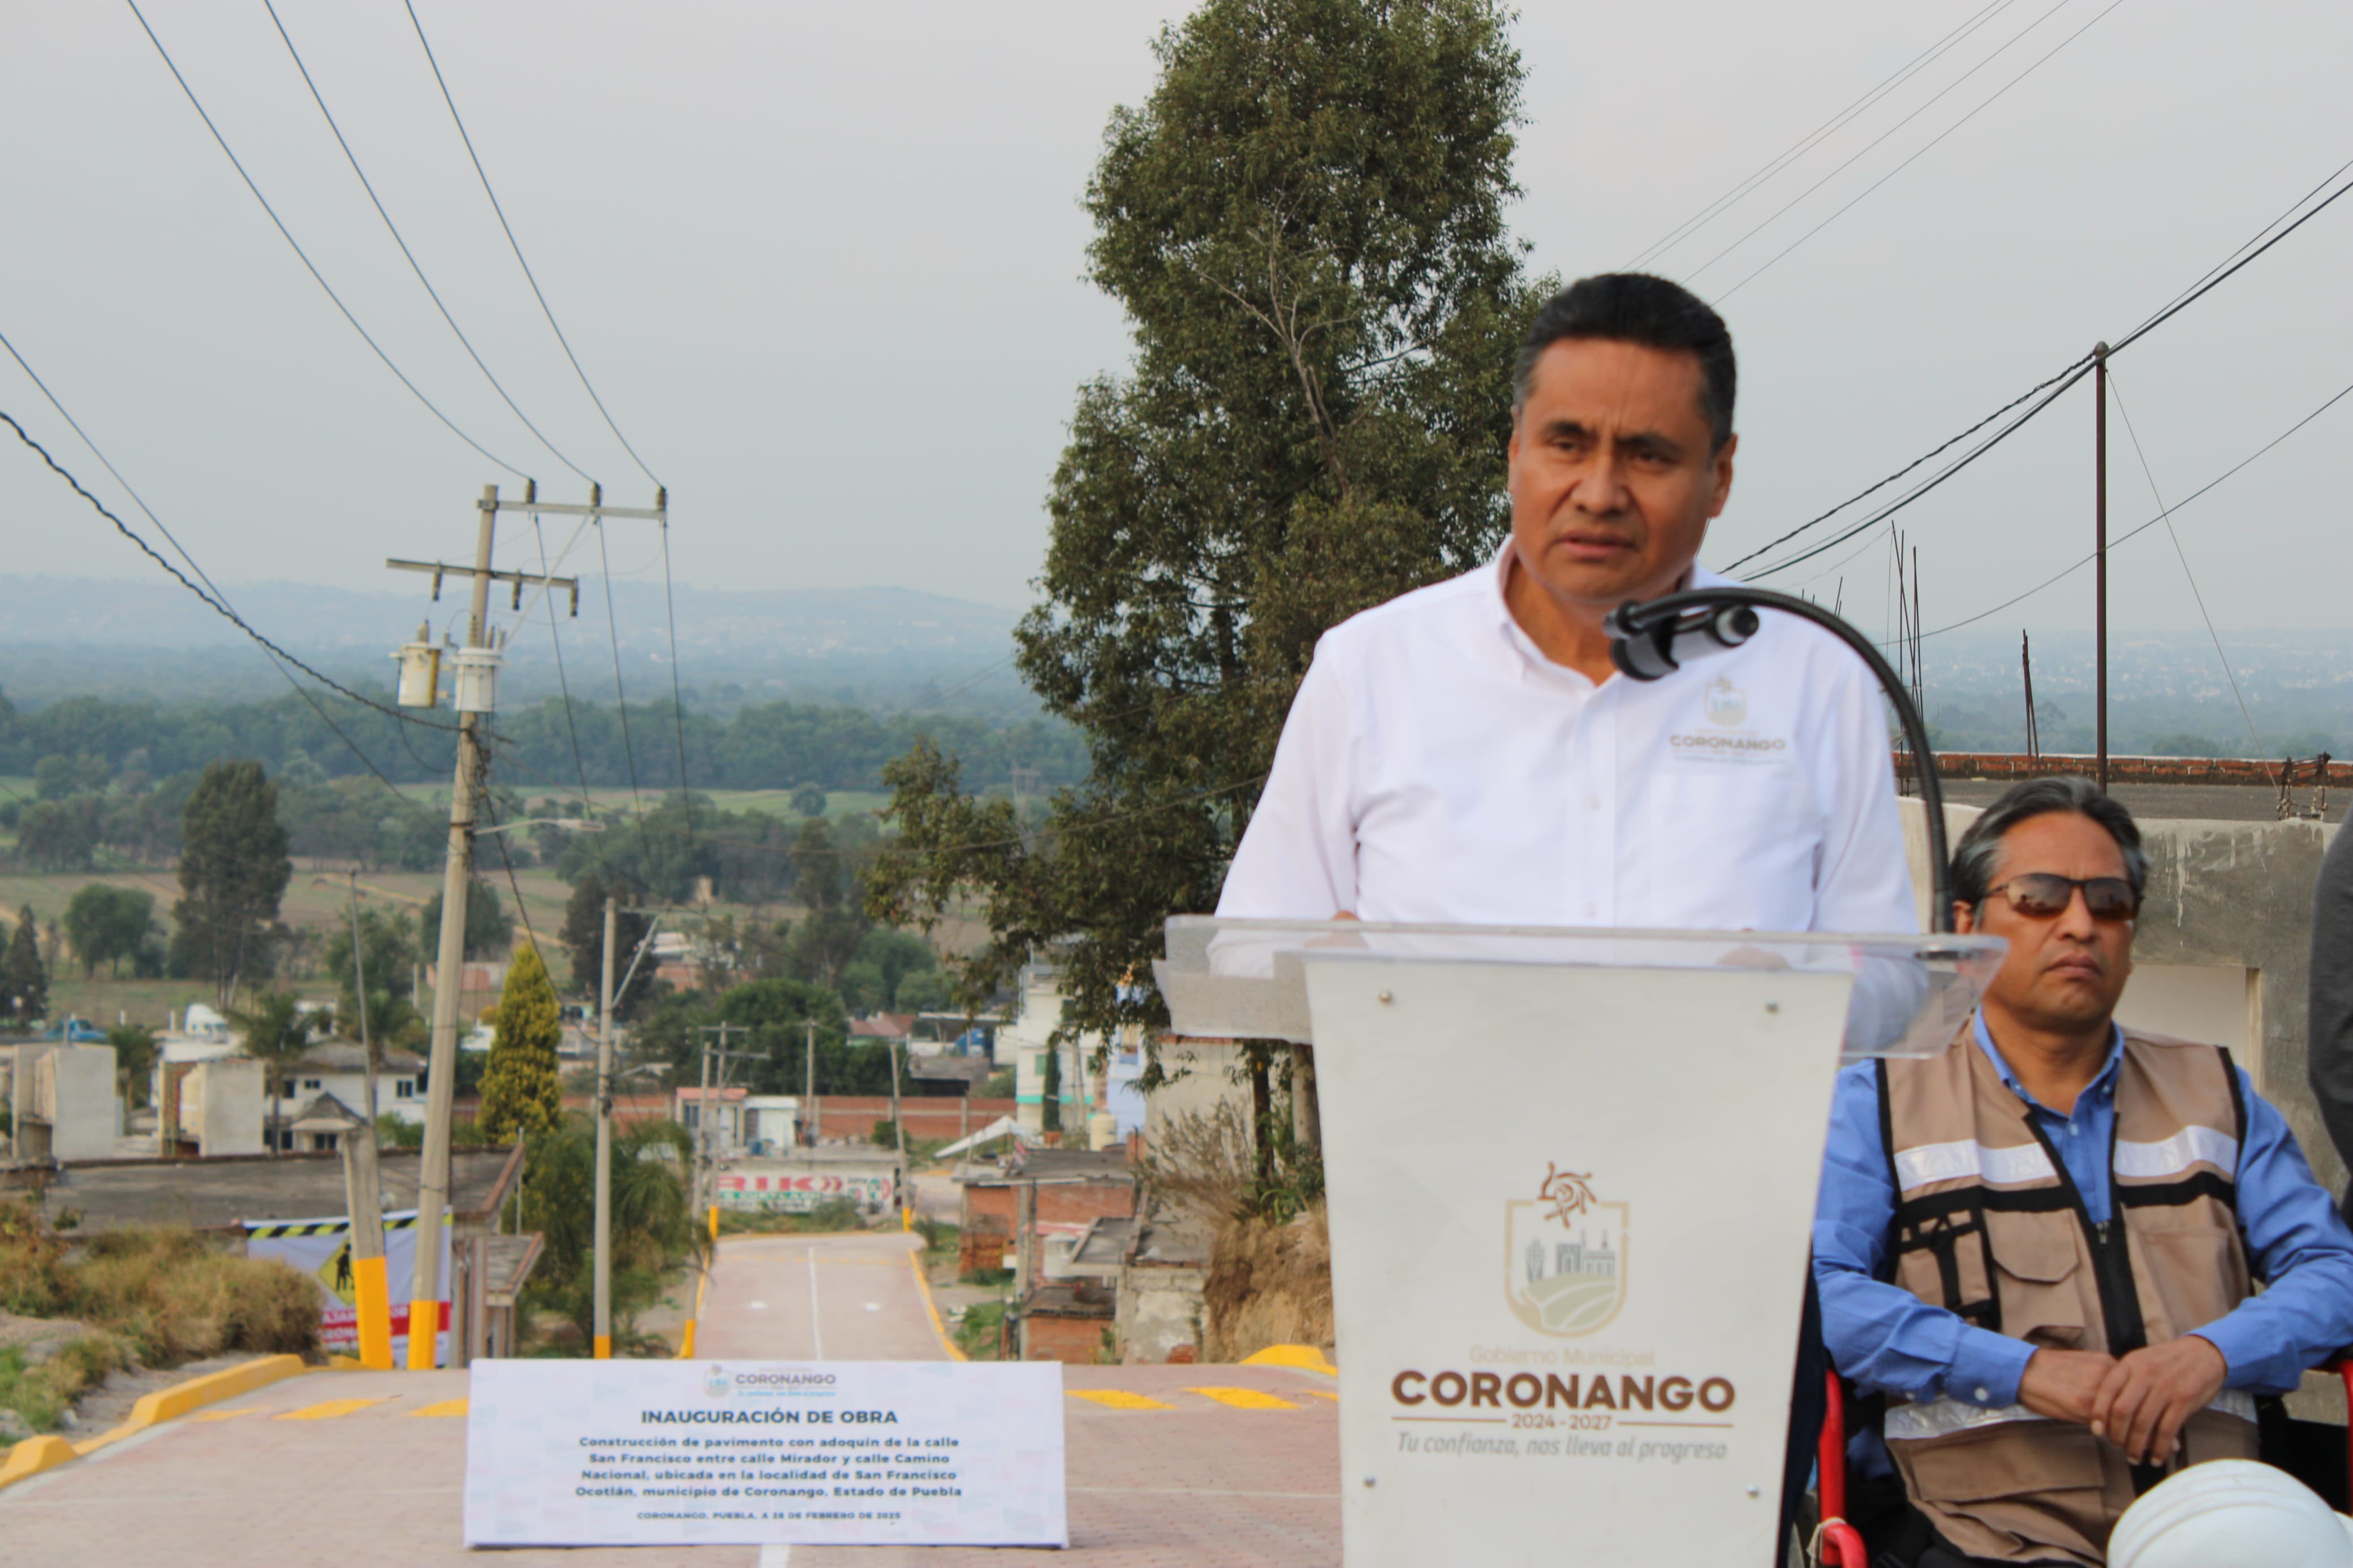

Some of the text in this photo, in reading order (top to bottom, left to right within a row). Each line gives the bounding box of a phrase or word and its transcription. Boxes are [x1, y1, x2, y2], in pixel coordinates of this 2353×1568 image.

[1670, 735, 1786, 751] CORONANGO
[1469, 1345, 1655, 1369] Gobierno Municipal
[736, 1375, 836, 1384] CORONANGO
[1391, 1370, 1735, 1414] CORONANGO
[643, 1408, 898, 1423] INAUGURACIÓN DE OBRA
[1511, 1414, 1556, 1429] 2024
[1569, 1415, 1612, 1430] 2027
[579, 1437, 677, 1447] Construcción
[682, 1437, 700, 1447] de
[705, 1438, 784, 1449] pavimento
[820, 1437, 880, 1449] adoquín
[885, 1437, 902, 1447] de
[907, 1437, 920, 1447] la
[925, 1437, 959, 1447] calle
[1398, 1432, 1729, 1465] Tu confianza, nos lleva al progreso
[589, 1453, 950, 1466] San Francisco entre calle Mirador y calle Camino
[582, 1470, 650, 1481] Nacional,
[655, 1470, 714, 1480] ubicada
[742, 1470, 755, 1480] la
[760, 1470, 827, 1480] localidad
[832, 1470, 850, 1480] de
[855, 1470, 882, 1480] San
[886, 1470, 957, 1480] Francisco
[576, 1486, 962, 1498] Ocotlán, municipio de Coronango, Estado de Puebla
[637, 1511, 709, 1520] CORONANGO,
[713, 1511, 757, 1520] PUEBLA,
